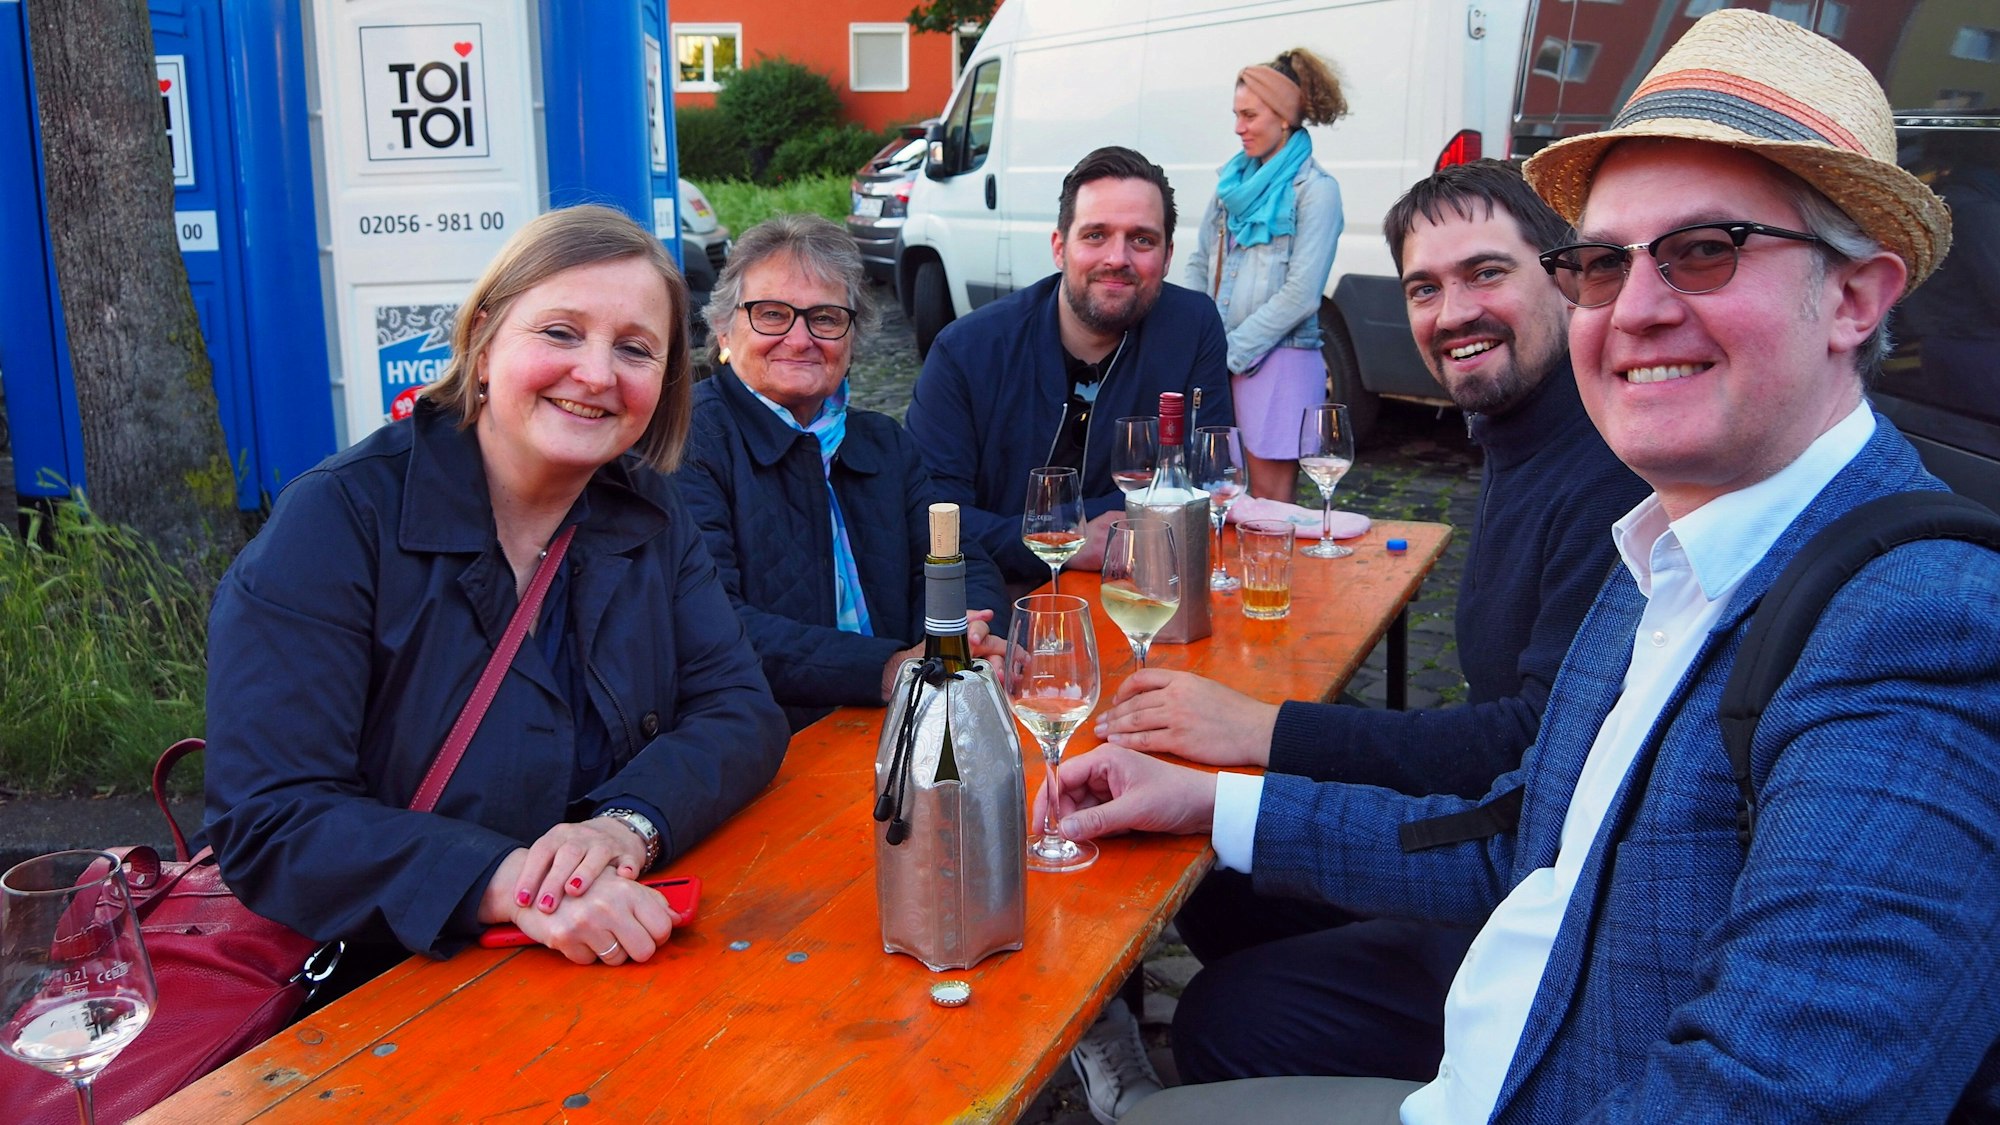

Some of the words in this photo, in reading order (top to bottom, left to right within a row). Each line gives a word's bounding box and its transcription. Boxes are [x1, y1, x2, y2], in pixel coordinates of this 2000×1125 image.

[389, 61, 471, 103] TOI
[392, 107, 474, 149] TOI
[182, 223, 203, 240] 00
[359, 214, 420, 235] 02056
[437, 213, 474, 232] 981
[480, 211, 505, 231] 00
